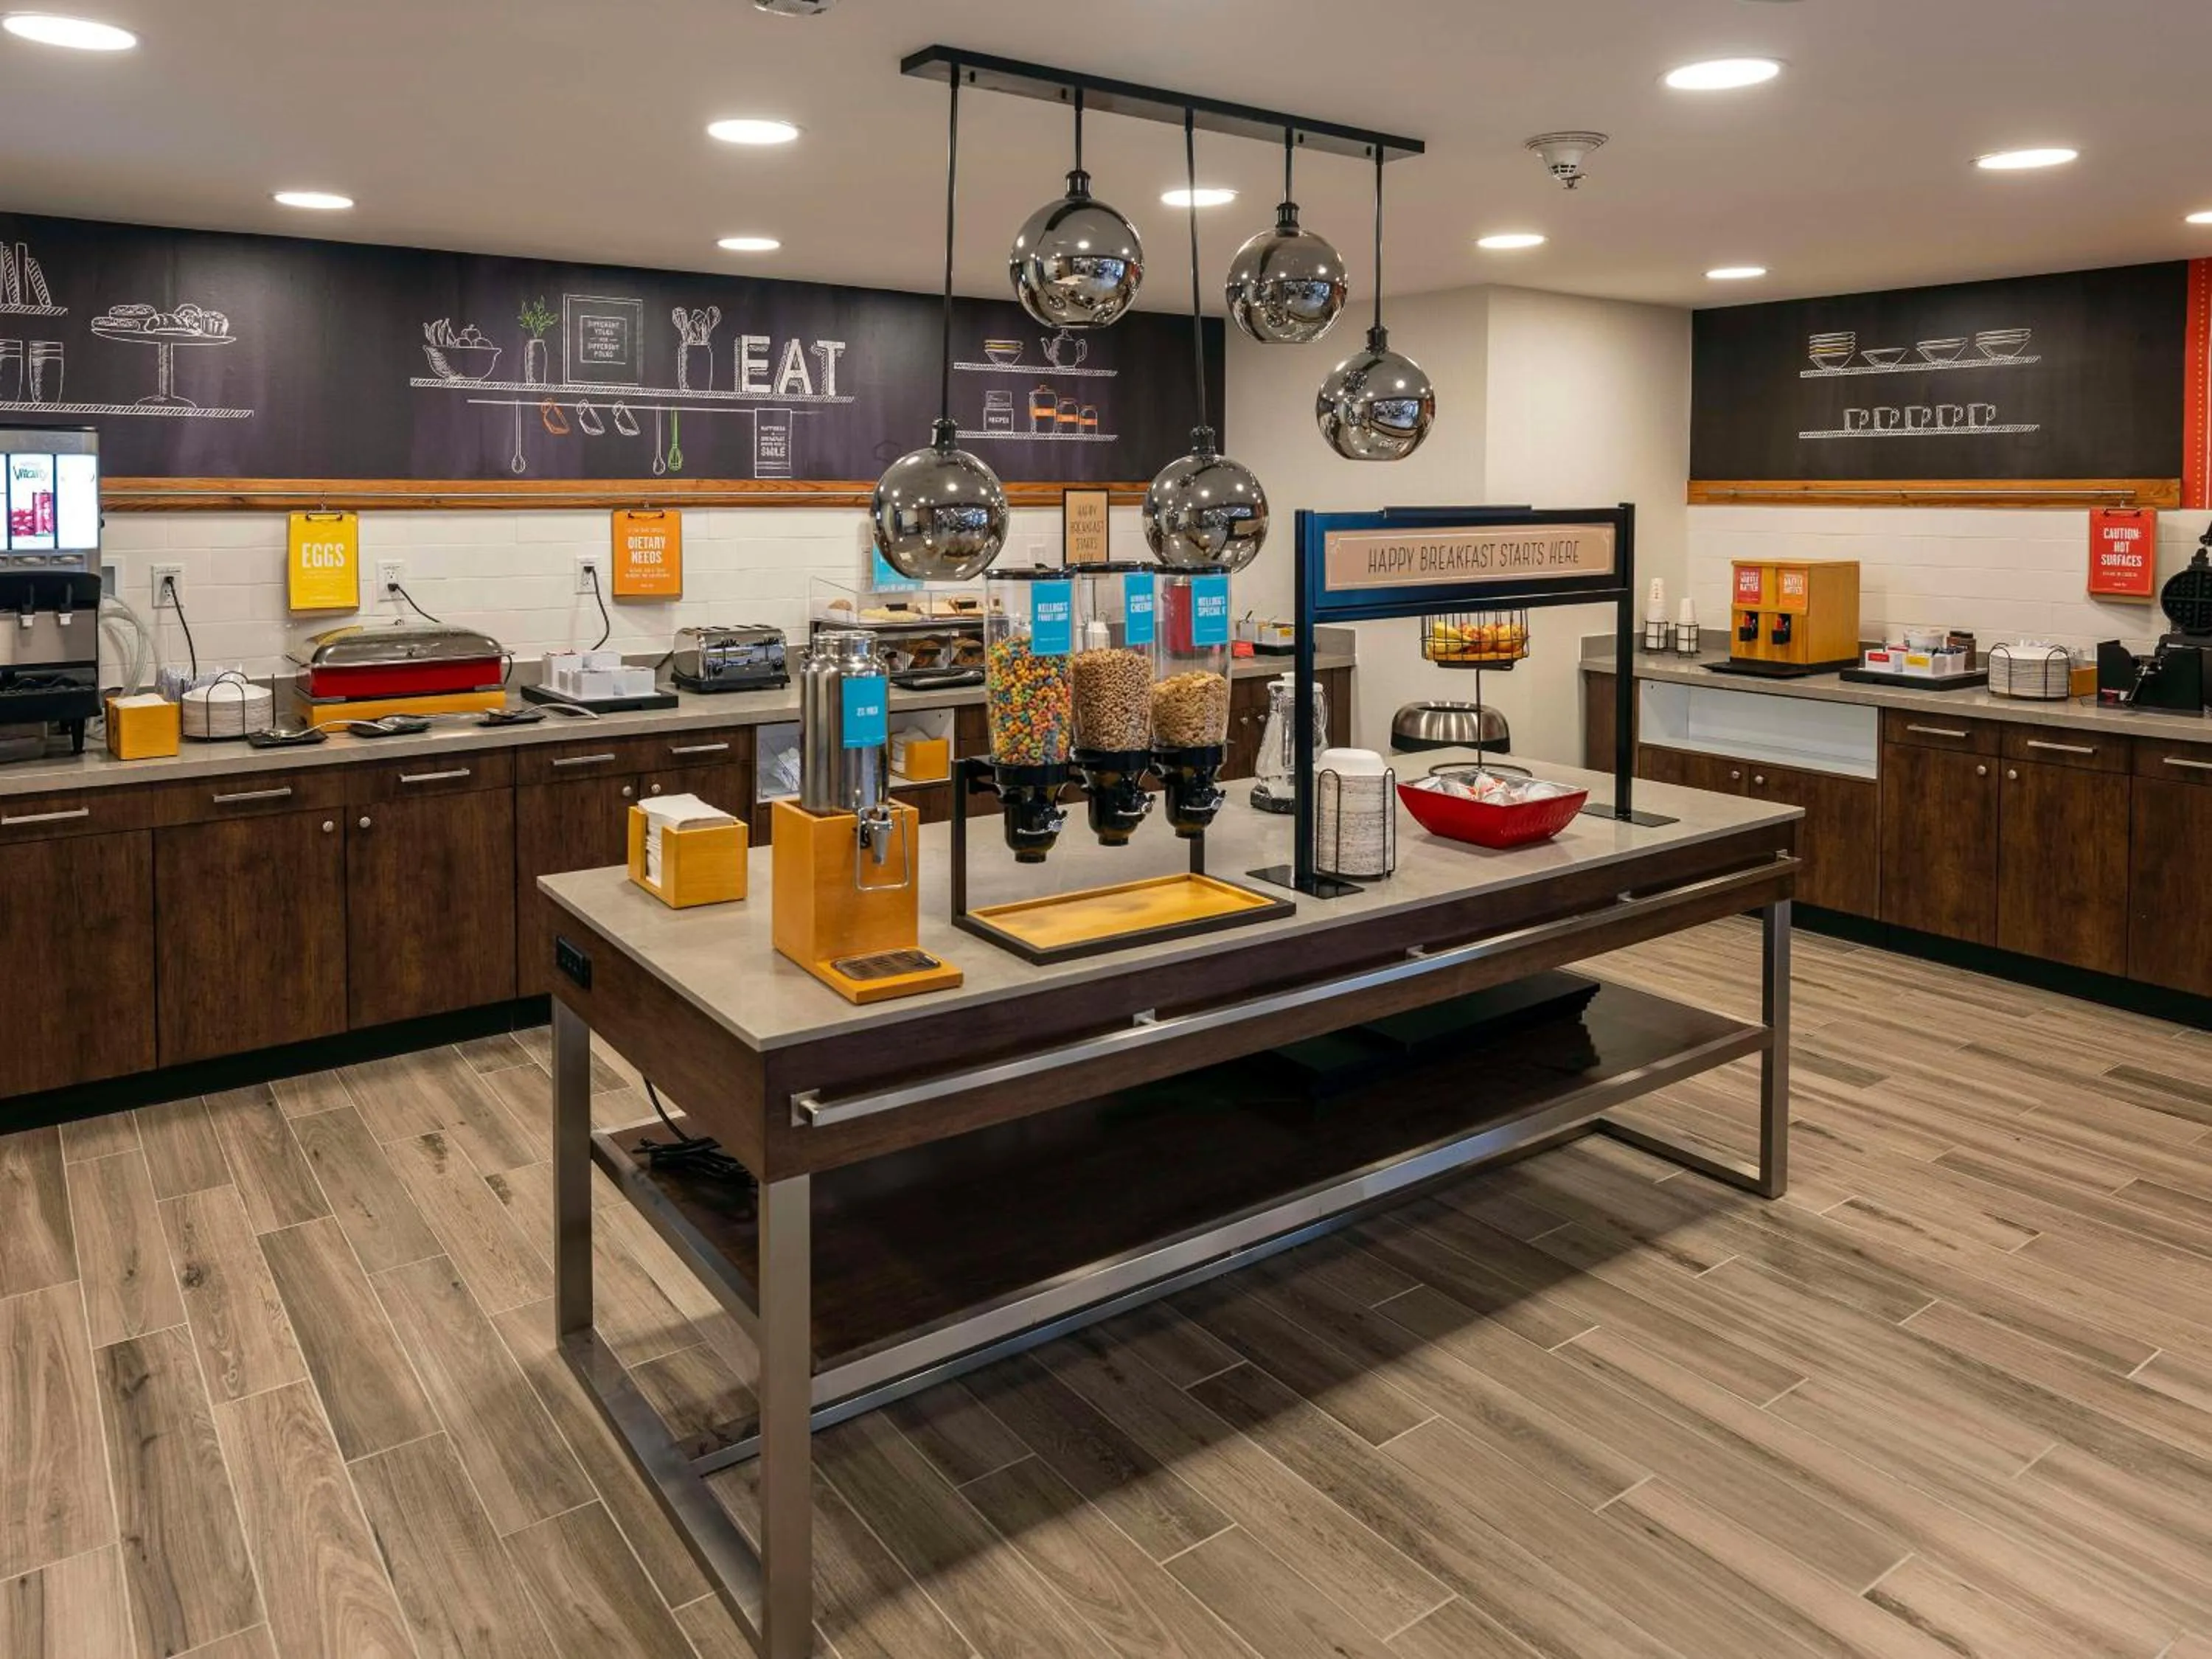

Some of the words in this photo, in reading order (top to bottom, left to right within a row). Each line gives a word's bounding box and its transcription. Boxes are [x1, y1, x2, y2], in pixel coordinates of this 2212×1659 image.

[734, 335, 846, 396] EAT
[760, 447, 785, 457] SMILE
[13, 465, 48, 481] Vitality
[627, 536, 666, 549] DIETARY
[2113, 540, 2130, 554] HOT
[302, 542, 346, 568] EGGS
[632, 551, 663, 564] NEEDS
[1368, 546, 1415, 574] HAPPY
[1419, 543, 1496, 571] BREAKFAST
[1499, 541, 1545, 568] STARTS
[1549, 540, 1581, 565] HERE
[2100, 554, 2143, 567] SURFACES
[1037, 602, 1068, 613] KELLOGG'S
[1197, 607, 1221, 618] SPECIAL
